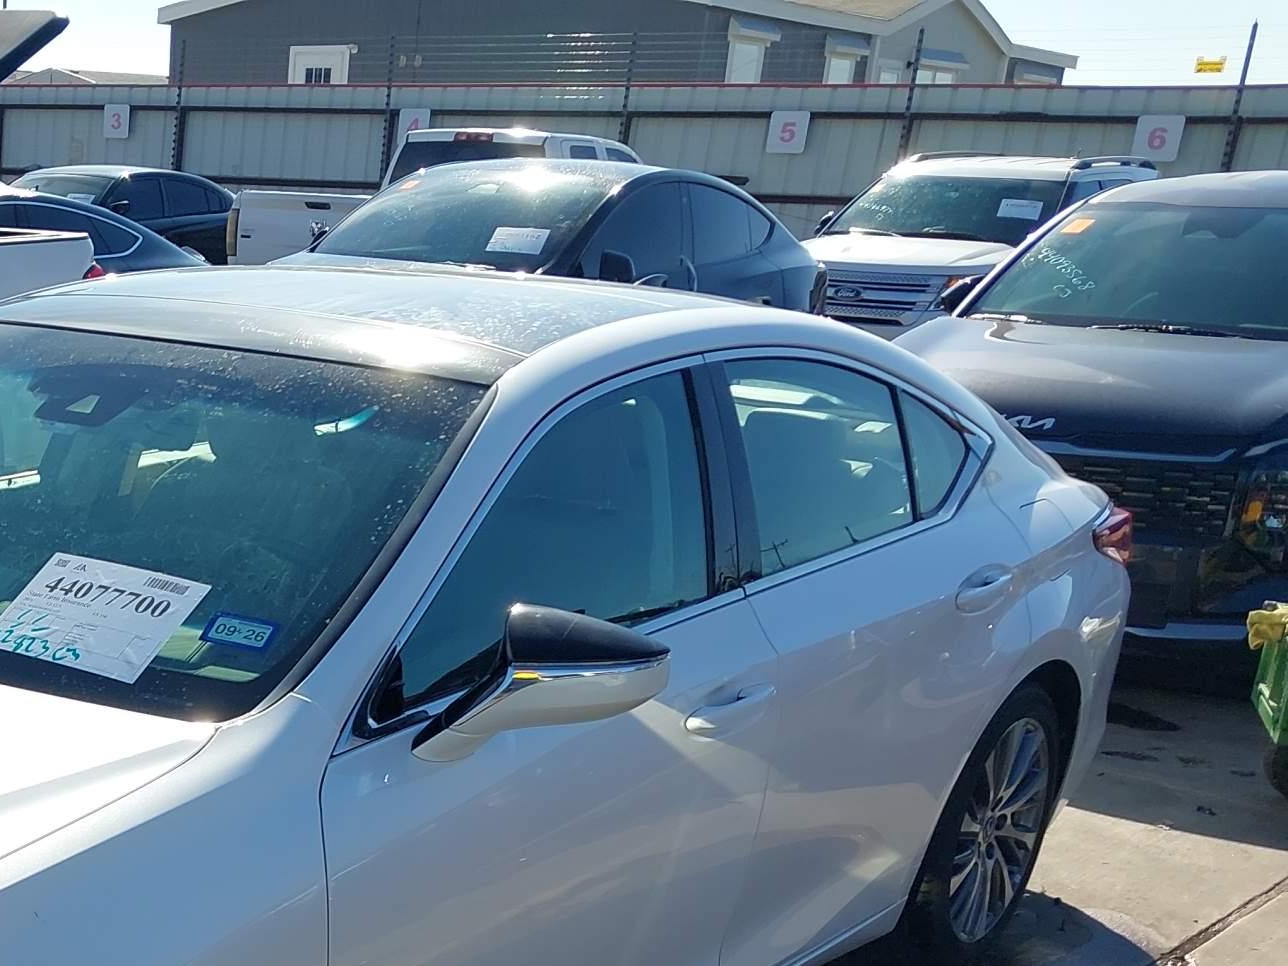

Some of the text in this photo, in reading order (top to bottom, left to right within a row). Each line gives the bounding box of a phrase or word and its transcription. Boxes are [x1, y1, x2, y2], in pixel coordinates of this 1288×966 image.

[111, 113, 122, 129] 3
[779, 121, 796, 143] 5
[1146, 127, 1168, 149] 6
[44, 575, 172, 619] 44077700
[214, 623, 267, 642] 09 26
